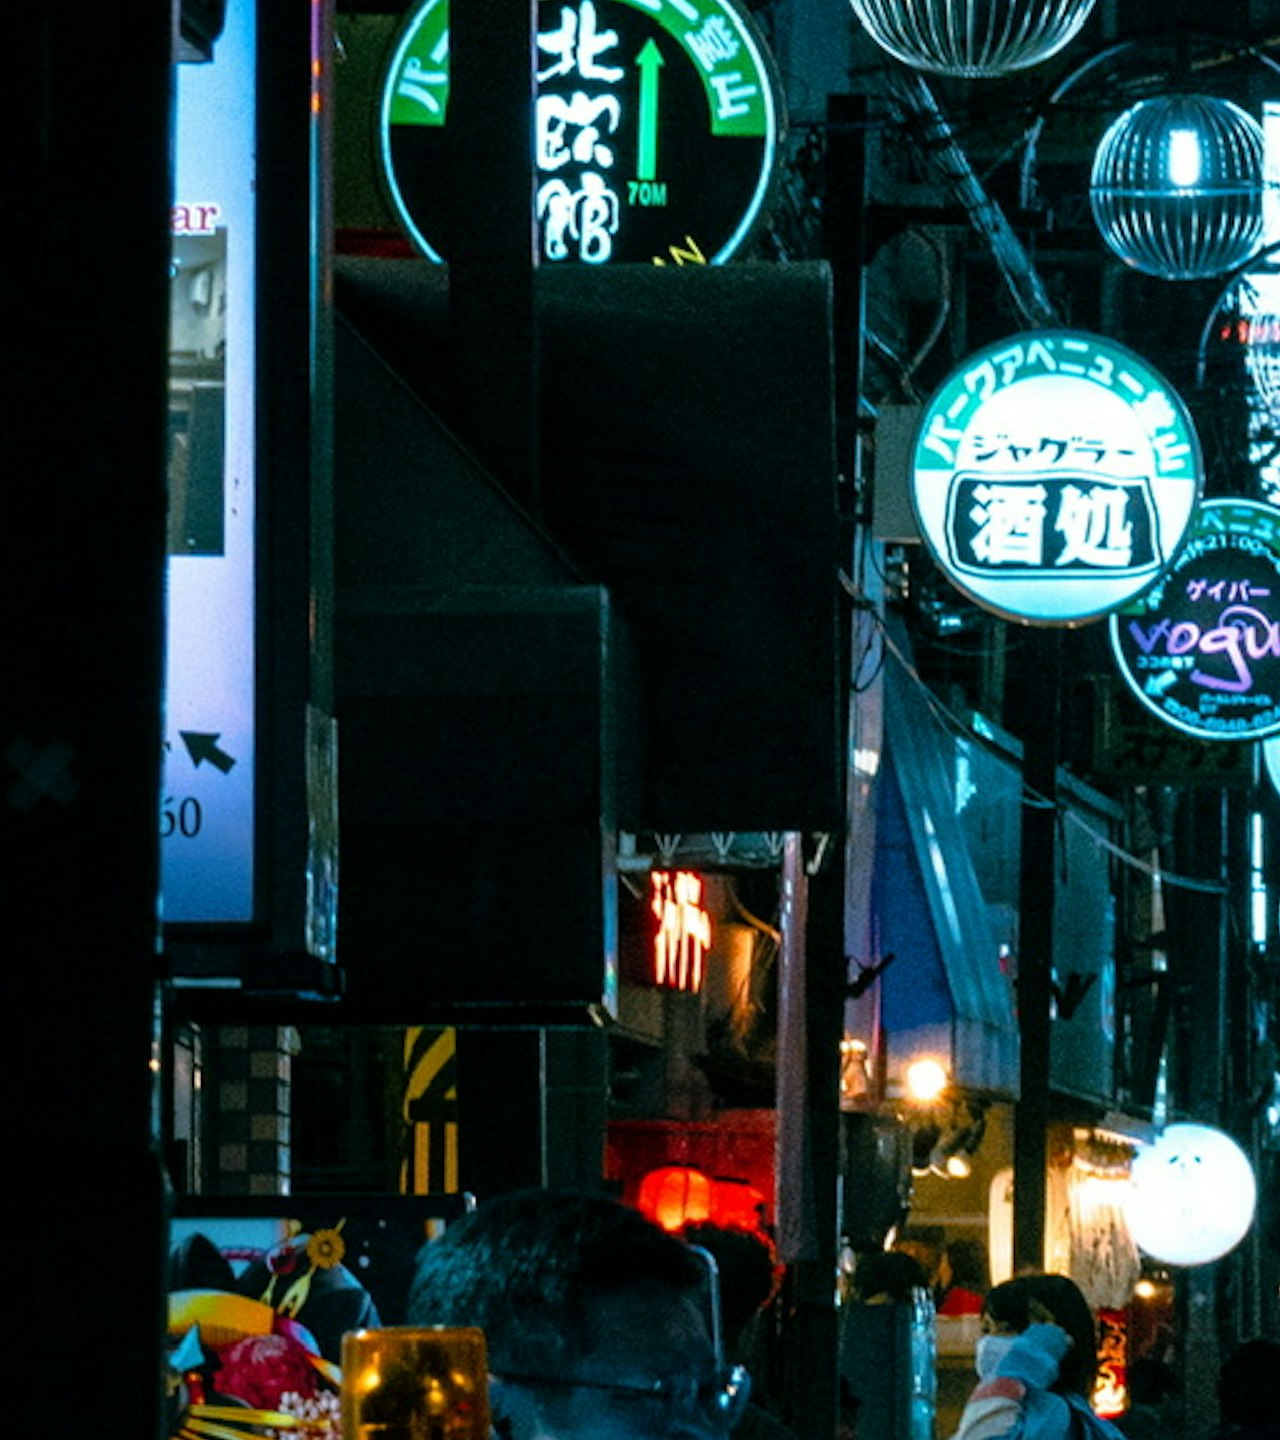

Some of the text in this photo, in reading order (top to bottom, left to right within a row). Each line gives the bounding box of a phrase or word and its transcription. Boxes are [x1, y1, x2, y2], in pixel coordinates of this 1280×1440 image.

[626, 181, 668, 208] 70M
[971, 433, 1137, 464] ジャグラー
[968, 482, 1134, 568] 酒処
[1186, 578, 1272, 603] ゲイバー
